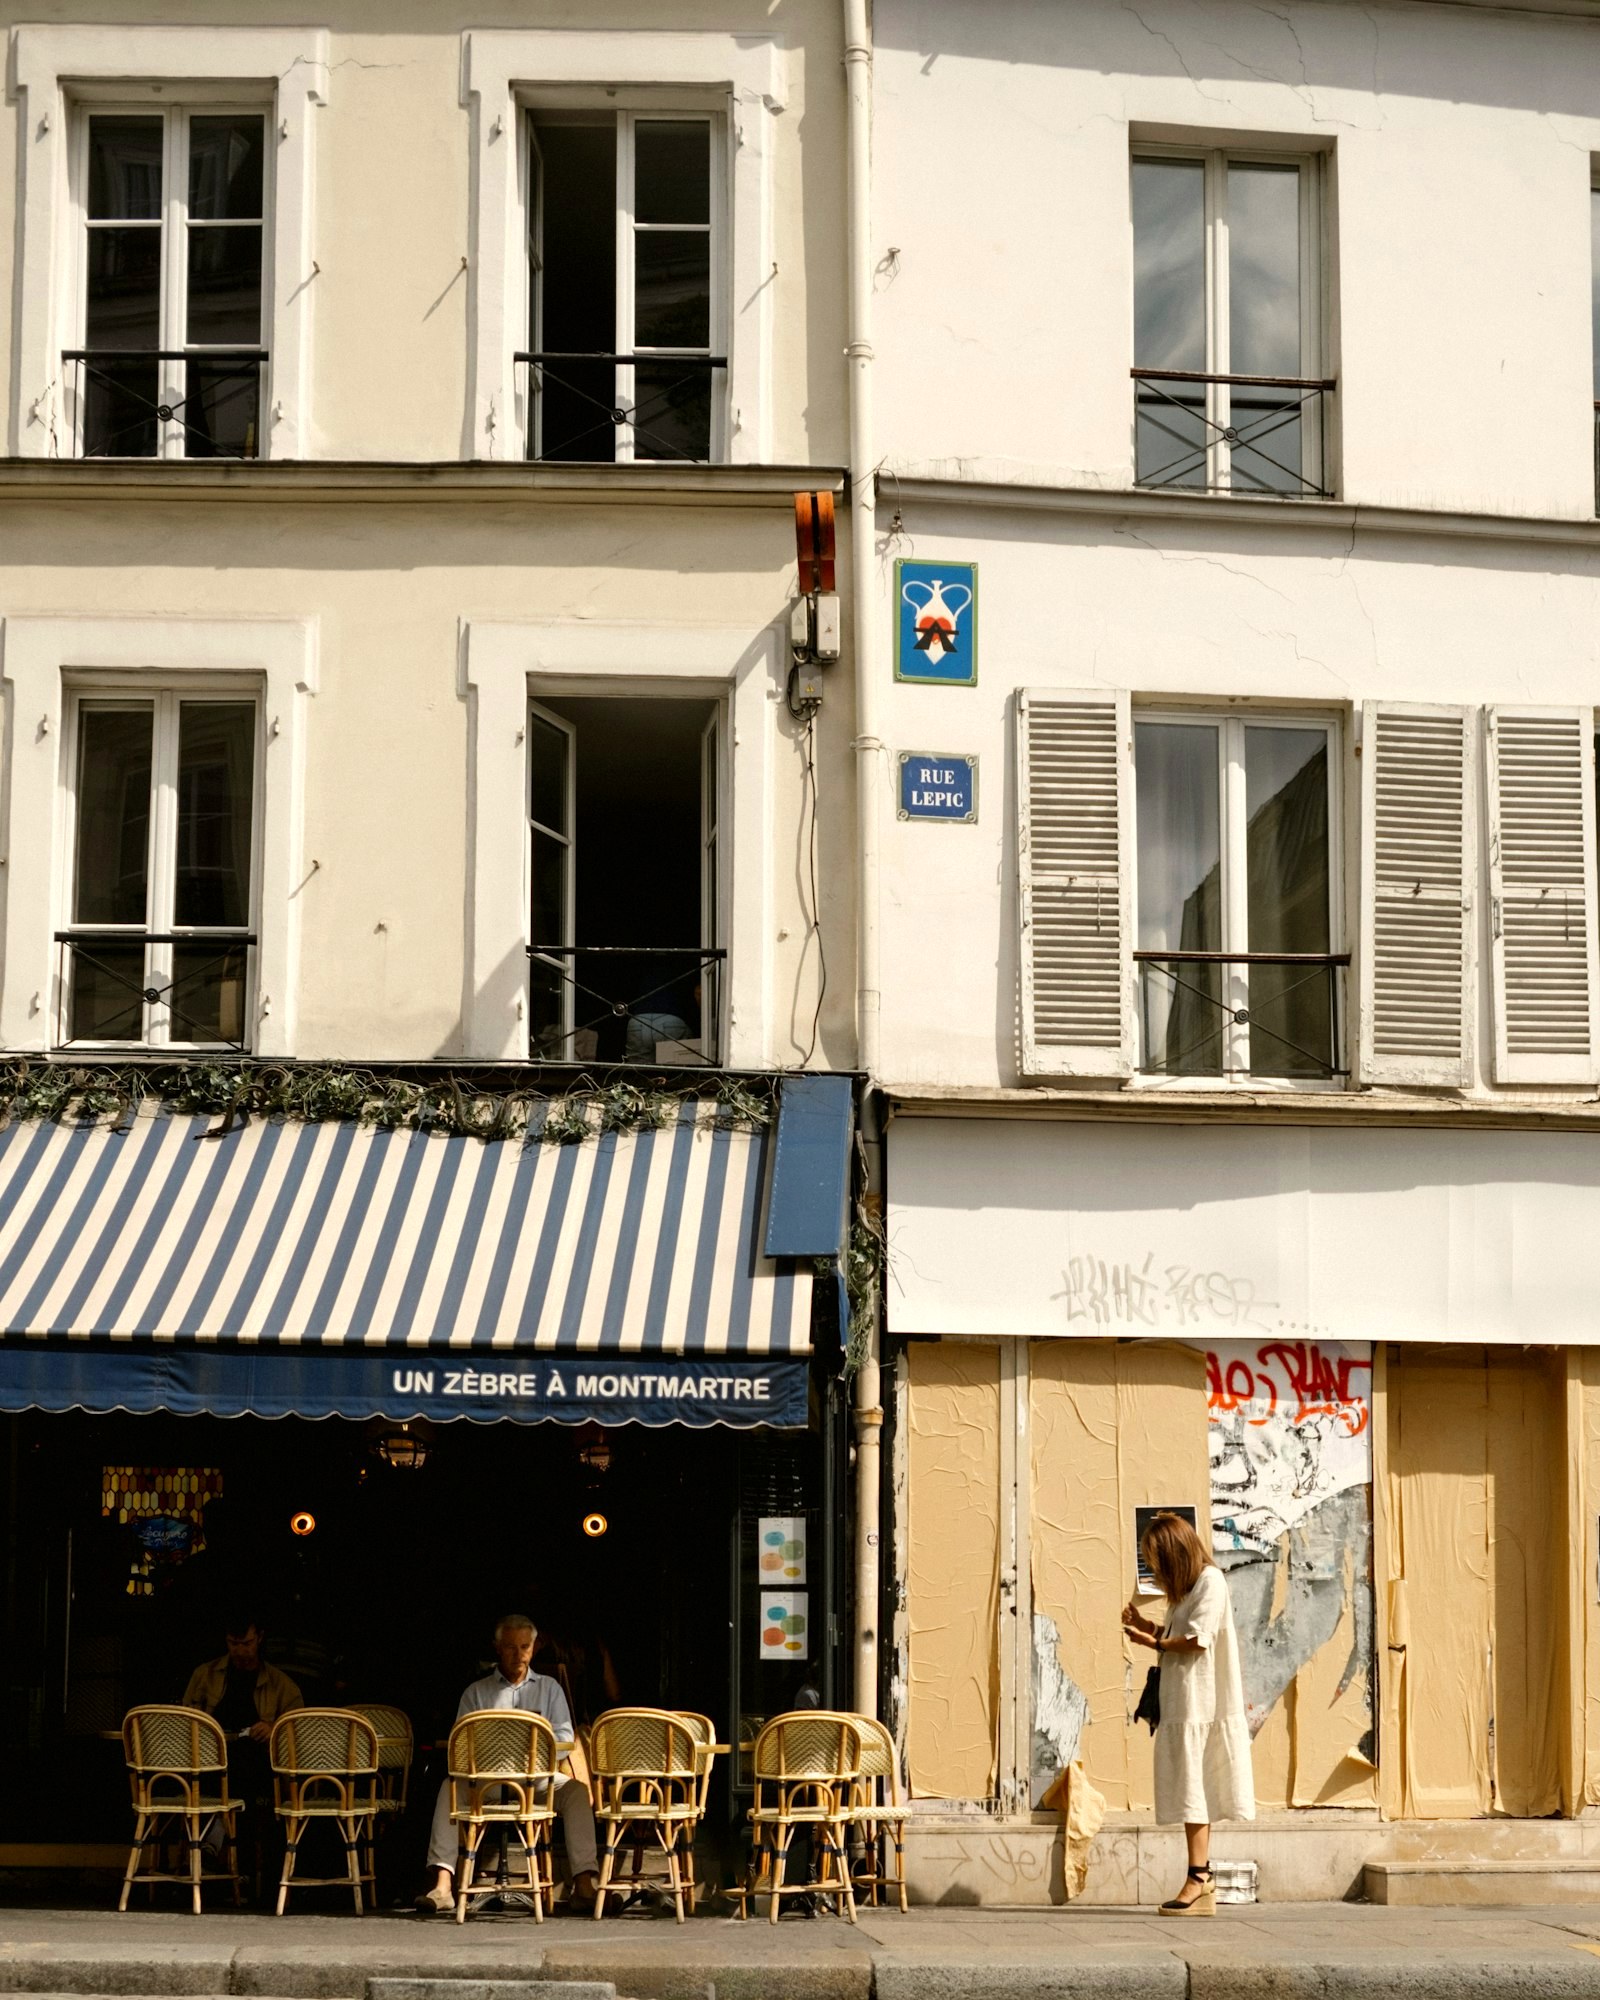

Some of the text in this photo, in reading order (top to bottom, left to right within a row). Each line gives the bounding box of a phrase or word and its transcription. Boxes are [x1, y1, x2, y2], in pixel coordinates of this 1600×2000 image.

[920, 768, 955, 785] RUE
[911, 790, 964, 808] LEPIC
[393, 1369, 771, 1401] UN ZÈBRE À MONTMARTRE
